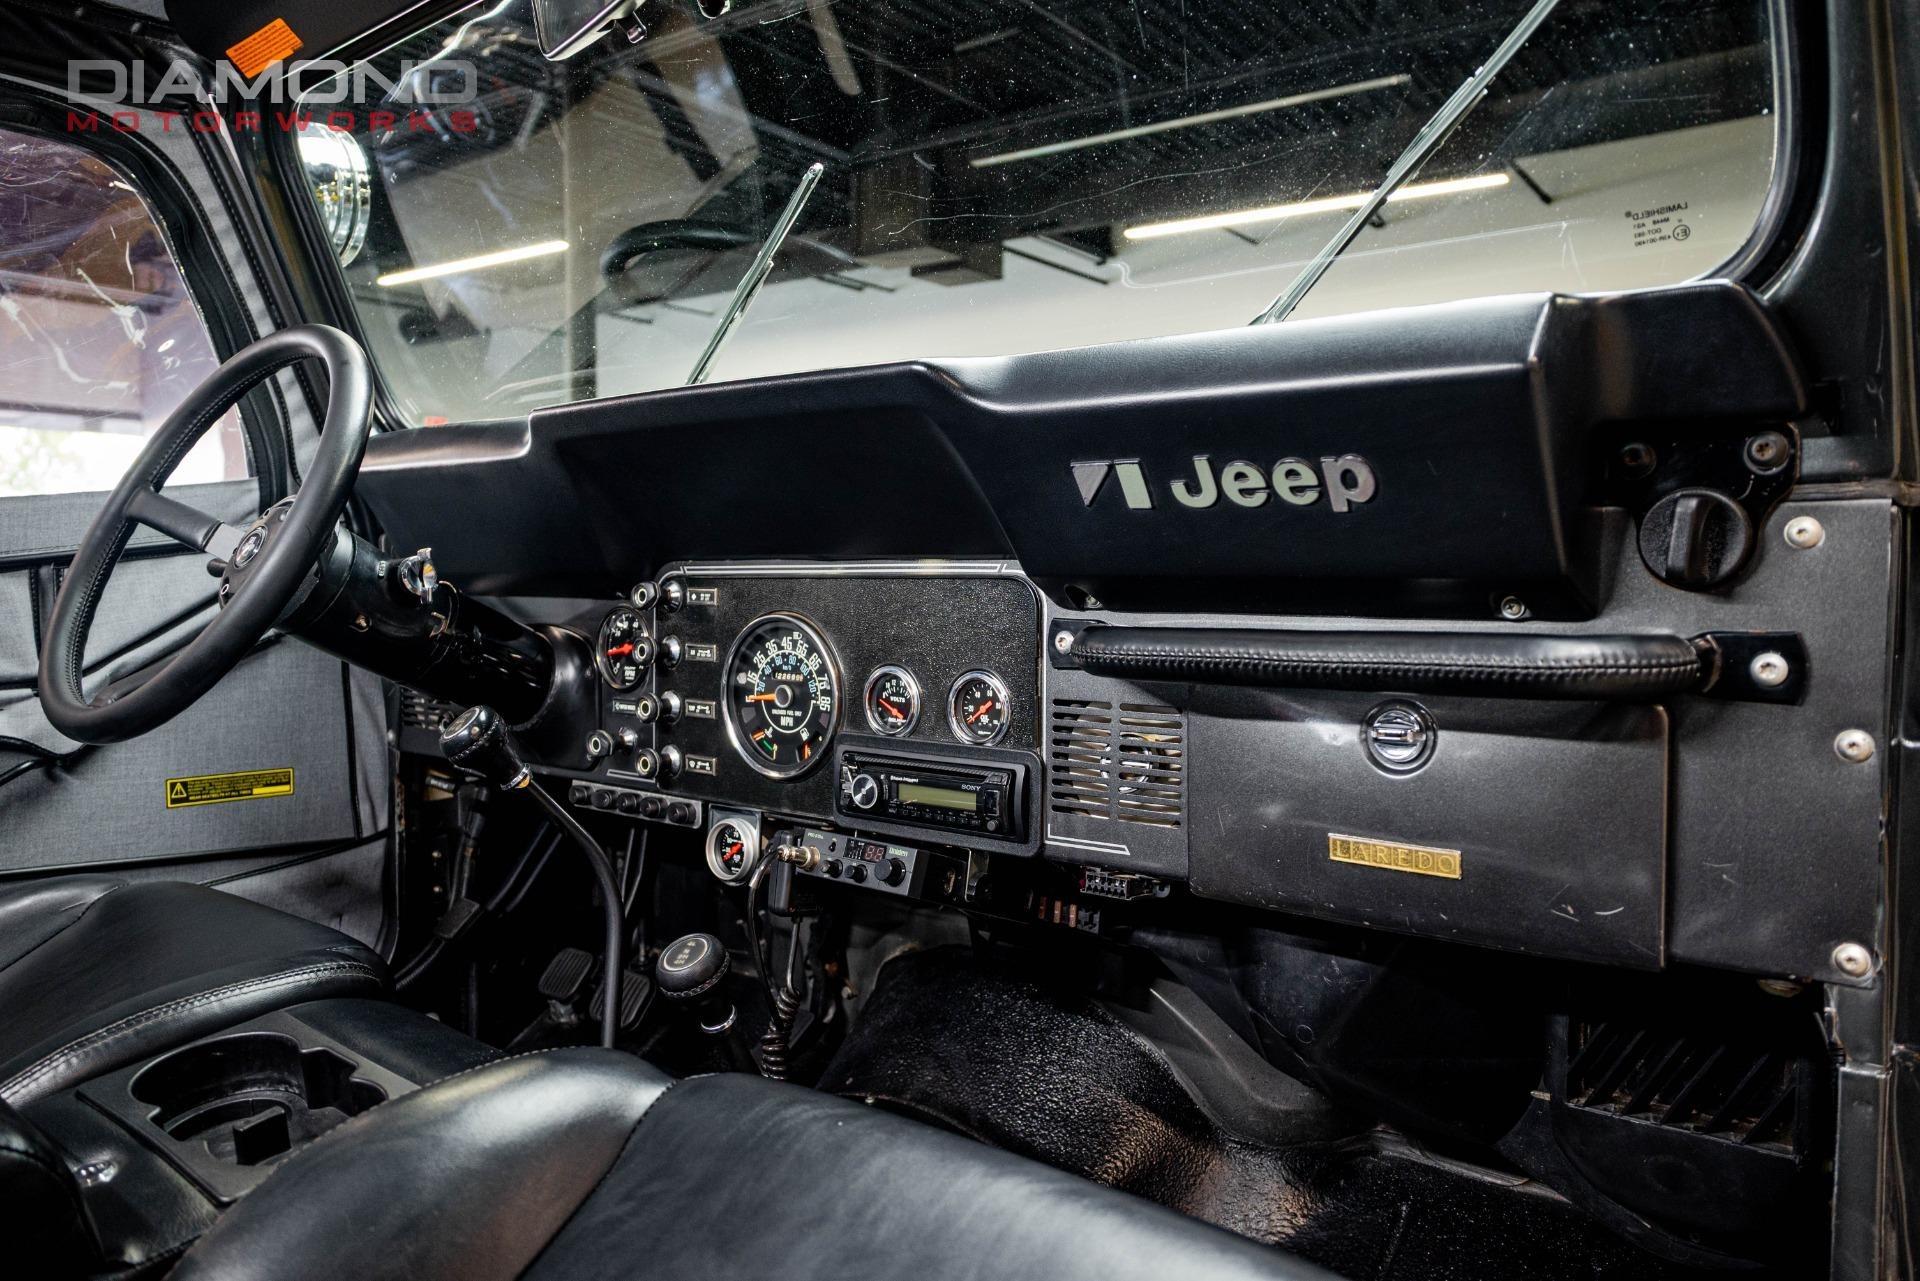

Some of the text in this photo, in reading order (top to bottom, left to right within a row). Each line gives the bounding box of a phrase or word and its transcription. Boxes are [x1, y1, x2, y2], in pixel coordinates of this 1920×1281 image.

[1169, 453, 1376, 513] Jeep
[766, 638, 778, 655] 35
[781, 636, 793, 651] 45
[796, 640, 809, 656] 55
[753, 650, 766, 668] 25
[809, 652, 822, 670] 65
[747, 669, 757, 684] 15
[820, 696, 831, 712] 85
[780, 716, 794, 727] MPH
[961, 783, 982, 792] SONY
[1336, 840, 1456, 873] LAREDO
